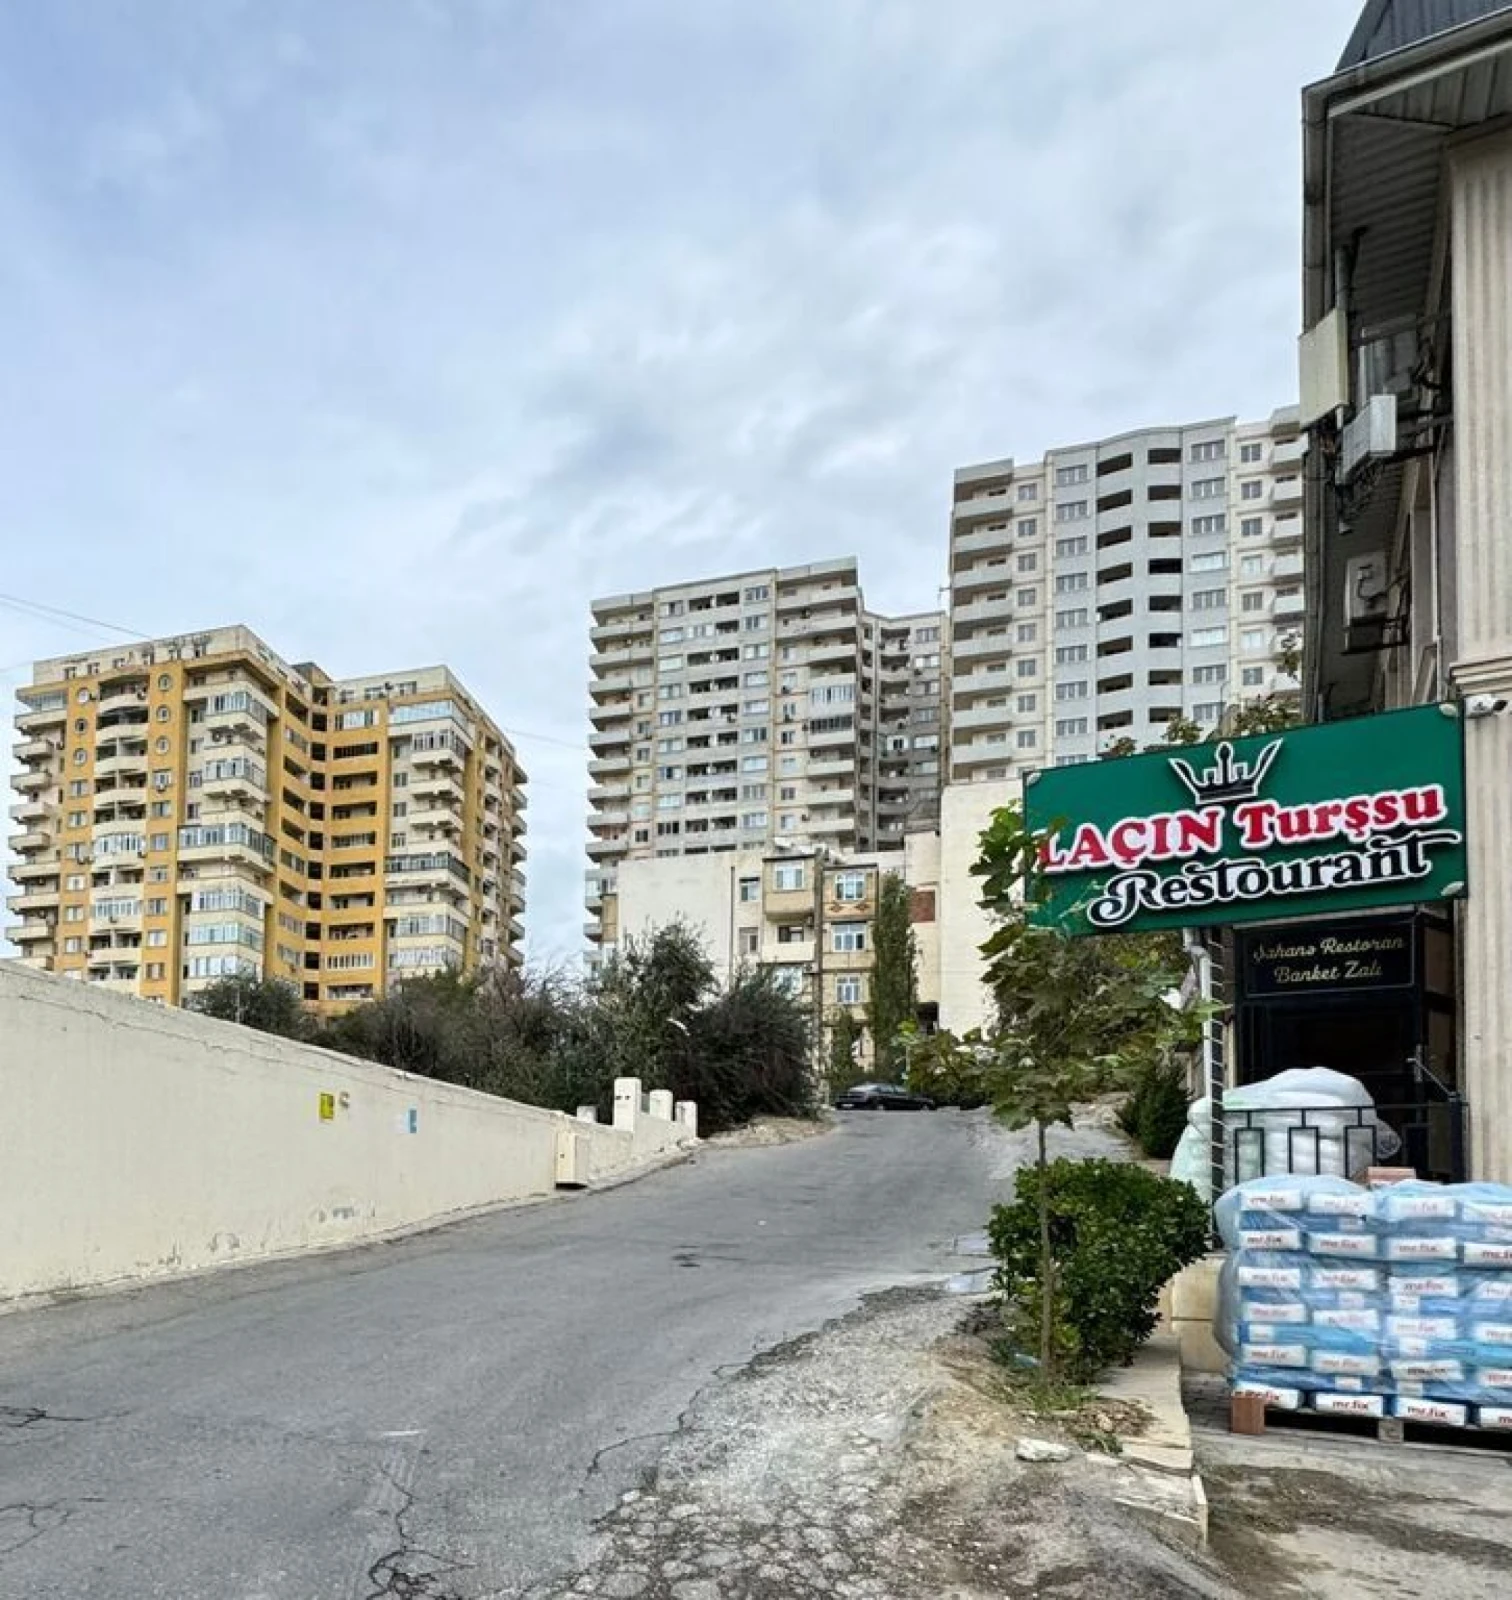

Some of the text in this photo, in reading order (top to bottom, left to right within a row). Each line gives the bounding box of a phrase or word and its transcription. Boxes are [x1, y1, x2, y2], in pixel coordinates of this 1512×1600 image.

[1036, 787, 1444, 867] LAÇIN Turşsu
[1088, 830, 1462, 925] Restourant
[1320, 937, 1405, 955] Restoran
[1274, 965, 1341, 984] Banket
[1332, 1399, 1369, 1411] mr.fix
[1407, 1405, 1447, 1419] mr.fix
